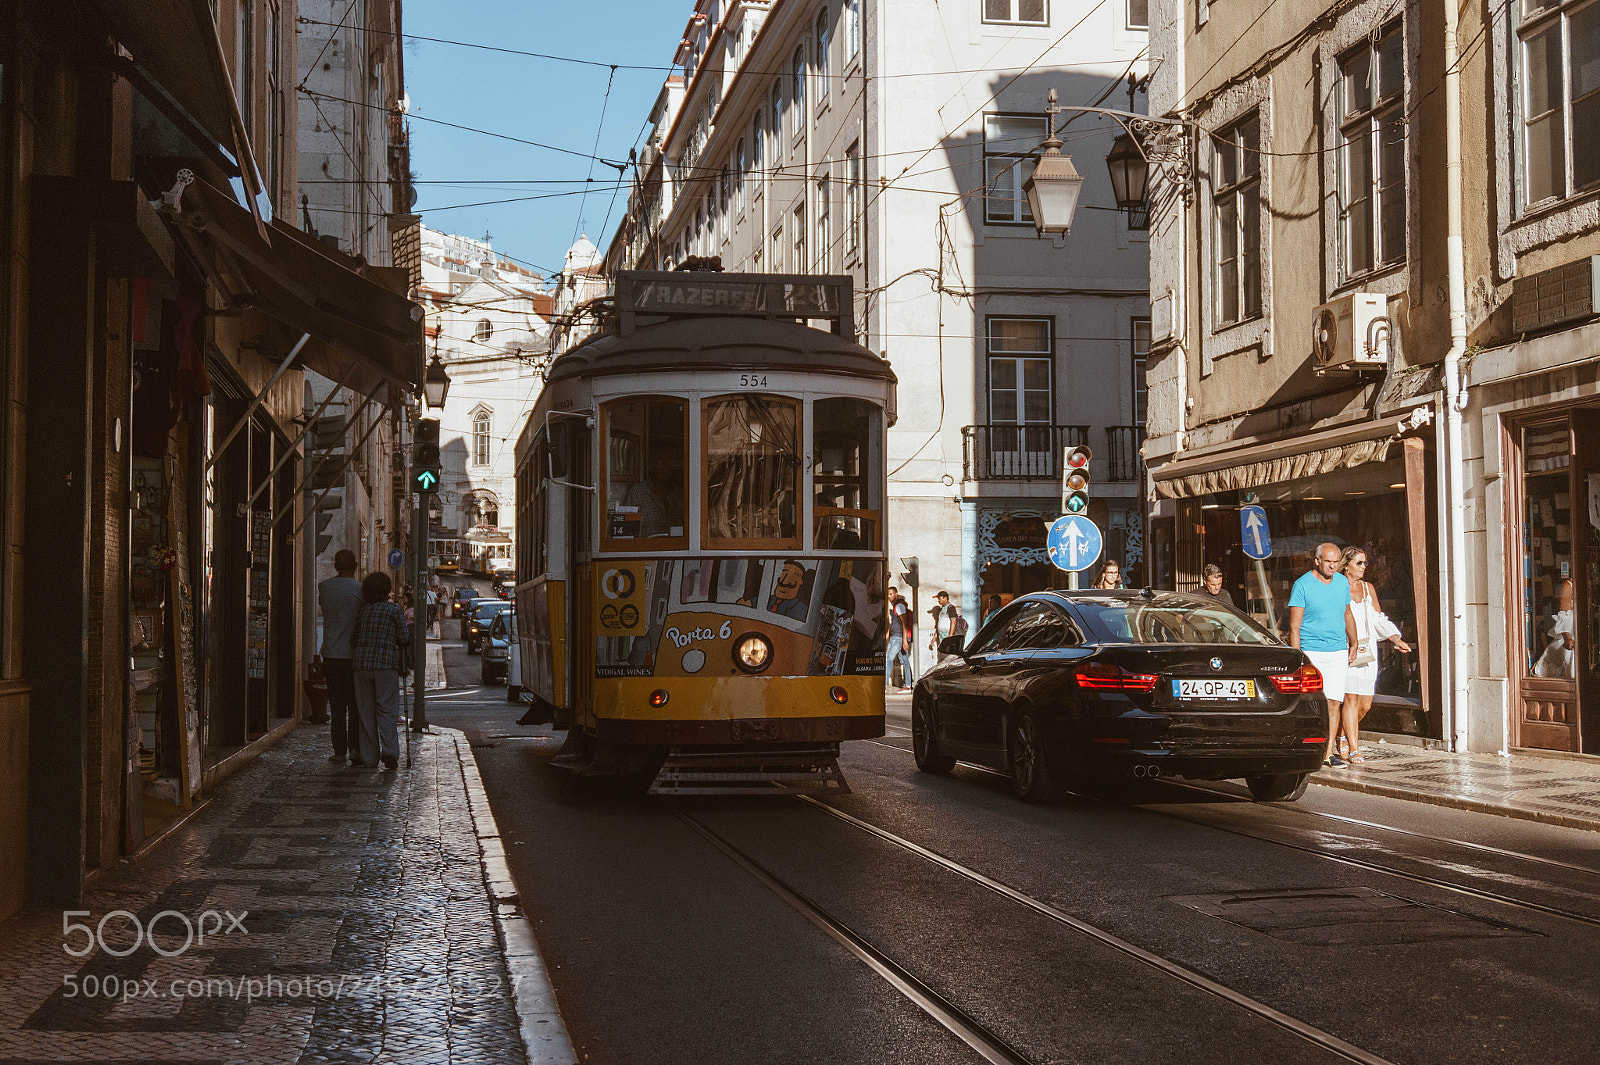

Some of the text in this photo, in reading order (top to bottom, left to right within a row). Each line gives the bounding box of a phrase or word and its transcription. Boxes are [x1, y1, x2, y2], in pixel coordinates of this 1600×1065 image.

[740, 374, 768, 388] 554
[613, 526, 624, 535] 14
[665, 619, 733, 649] Porta 6
[596, 668, 651, 676] VIDIGAL WINES
